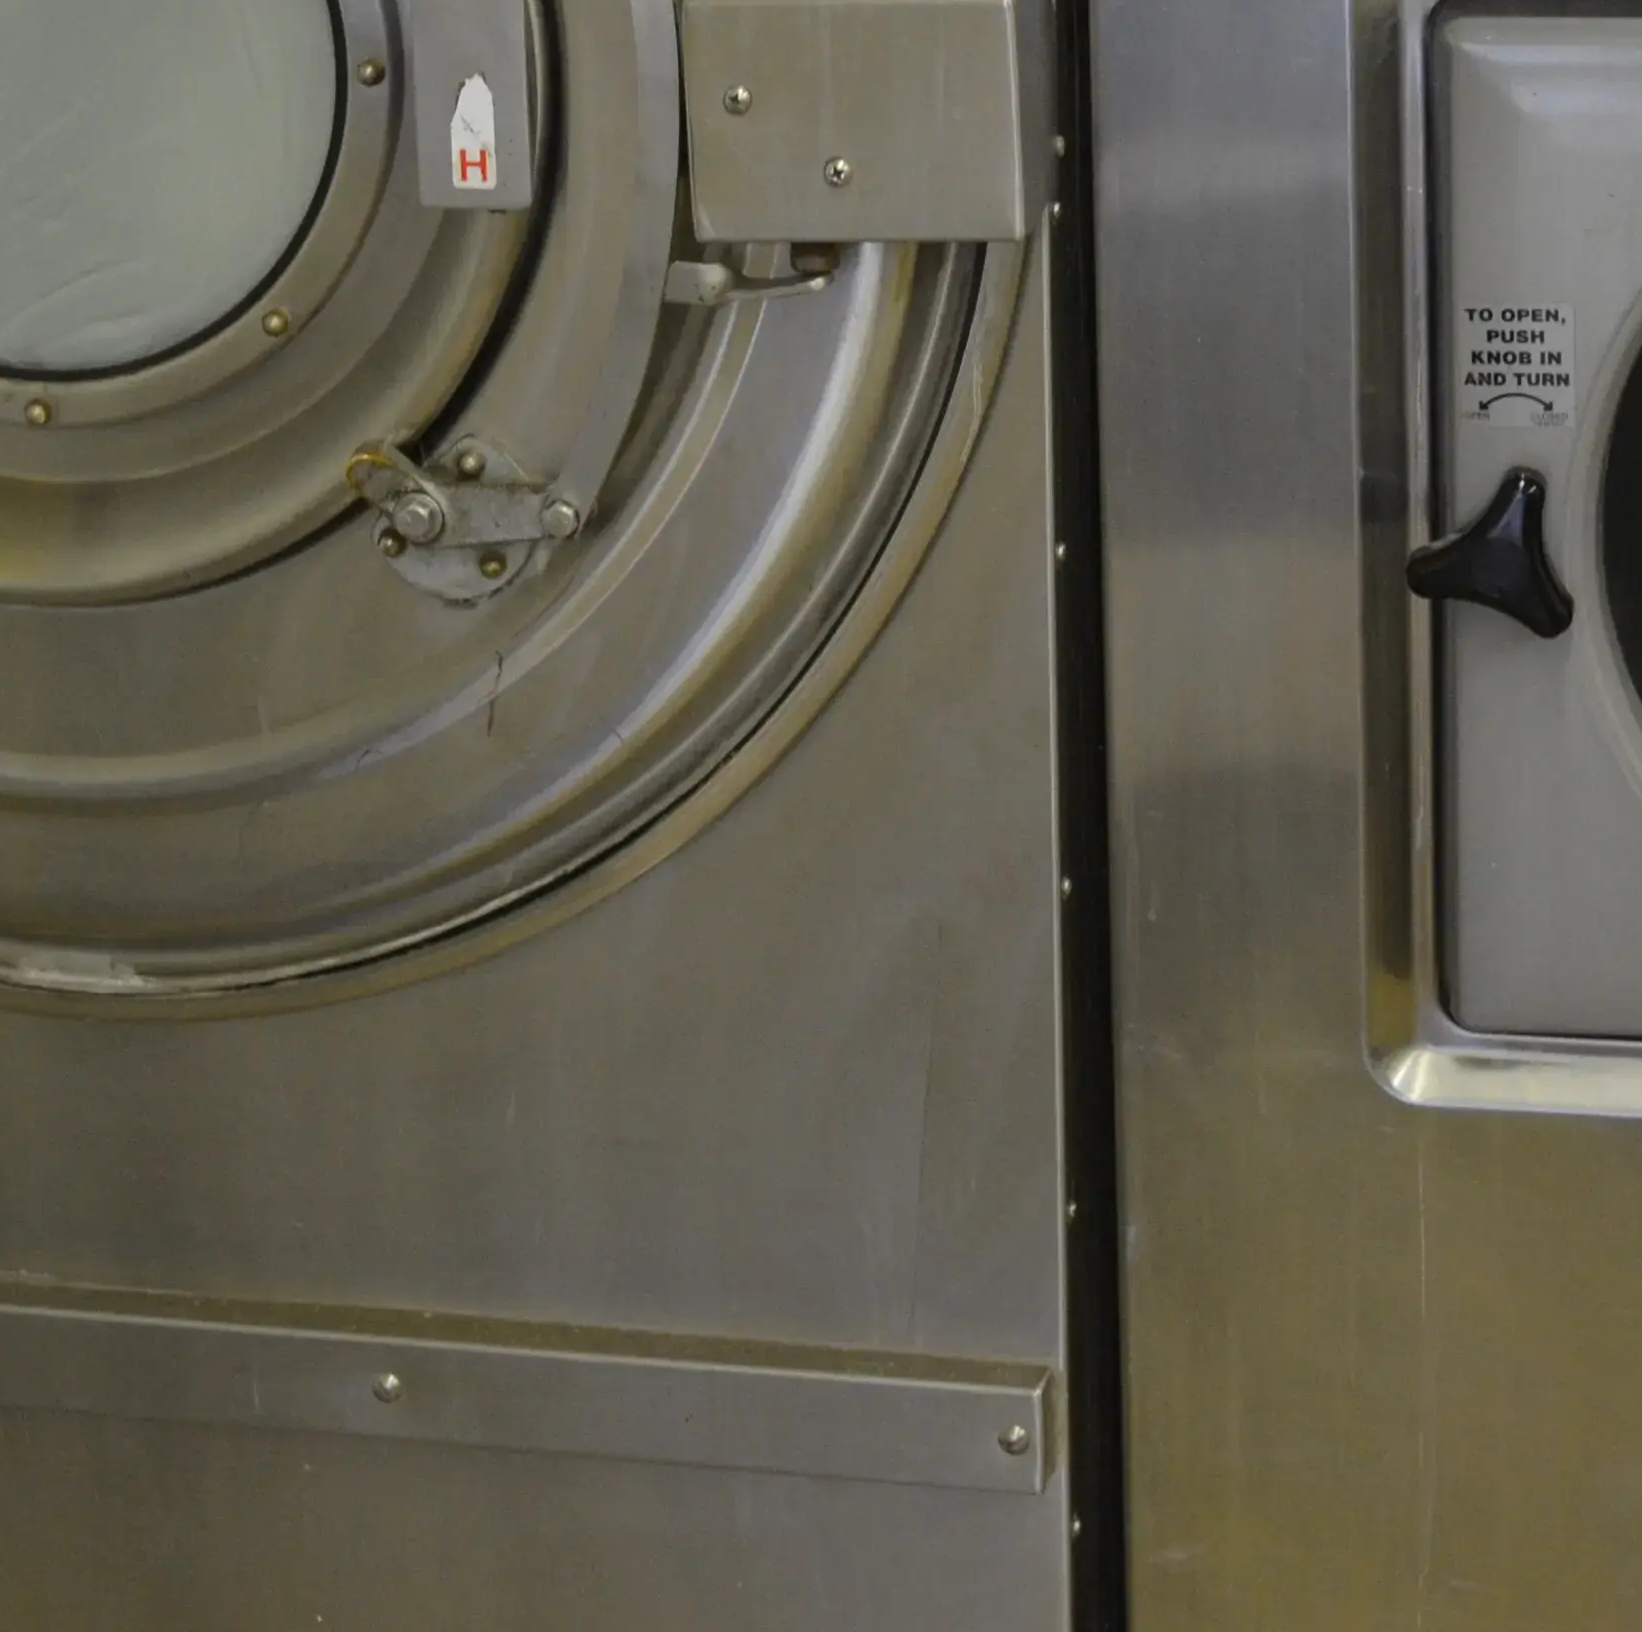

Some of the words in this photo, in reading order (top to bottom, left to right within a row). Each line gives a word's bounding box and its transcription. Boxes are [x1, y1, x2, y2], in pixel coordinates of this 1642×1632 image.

[460, 149, 487, 182] H
[1464, 308, 1493, 322] TO
[1501, 308, 1566, 325] OPEN,
[1486, 330, 1544, 344] PUSH
[1471, 350, 1532, 365] KNOB
[1540, 351, 1562, 365] IN
[1464, 372, 1506, 386] AND
[1514, 372, 1570, 386] TURN
